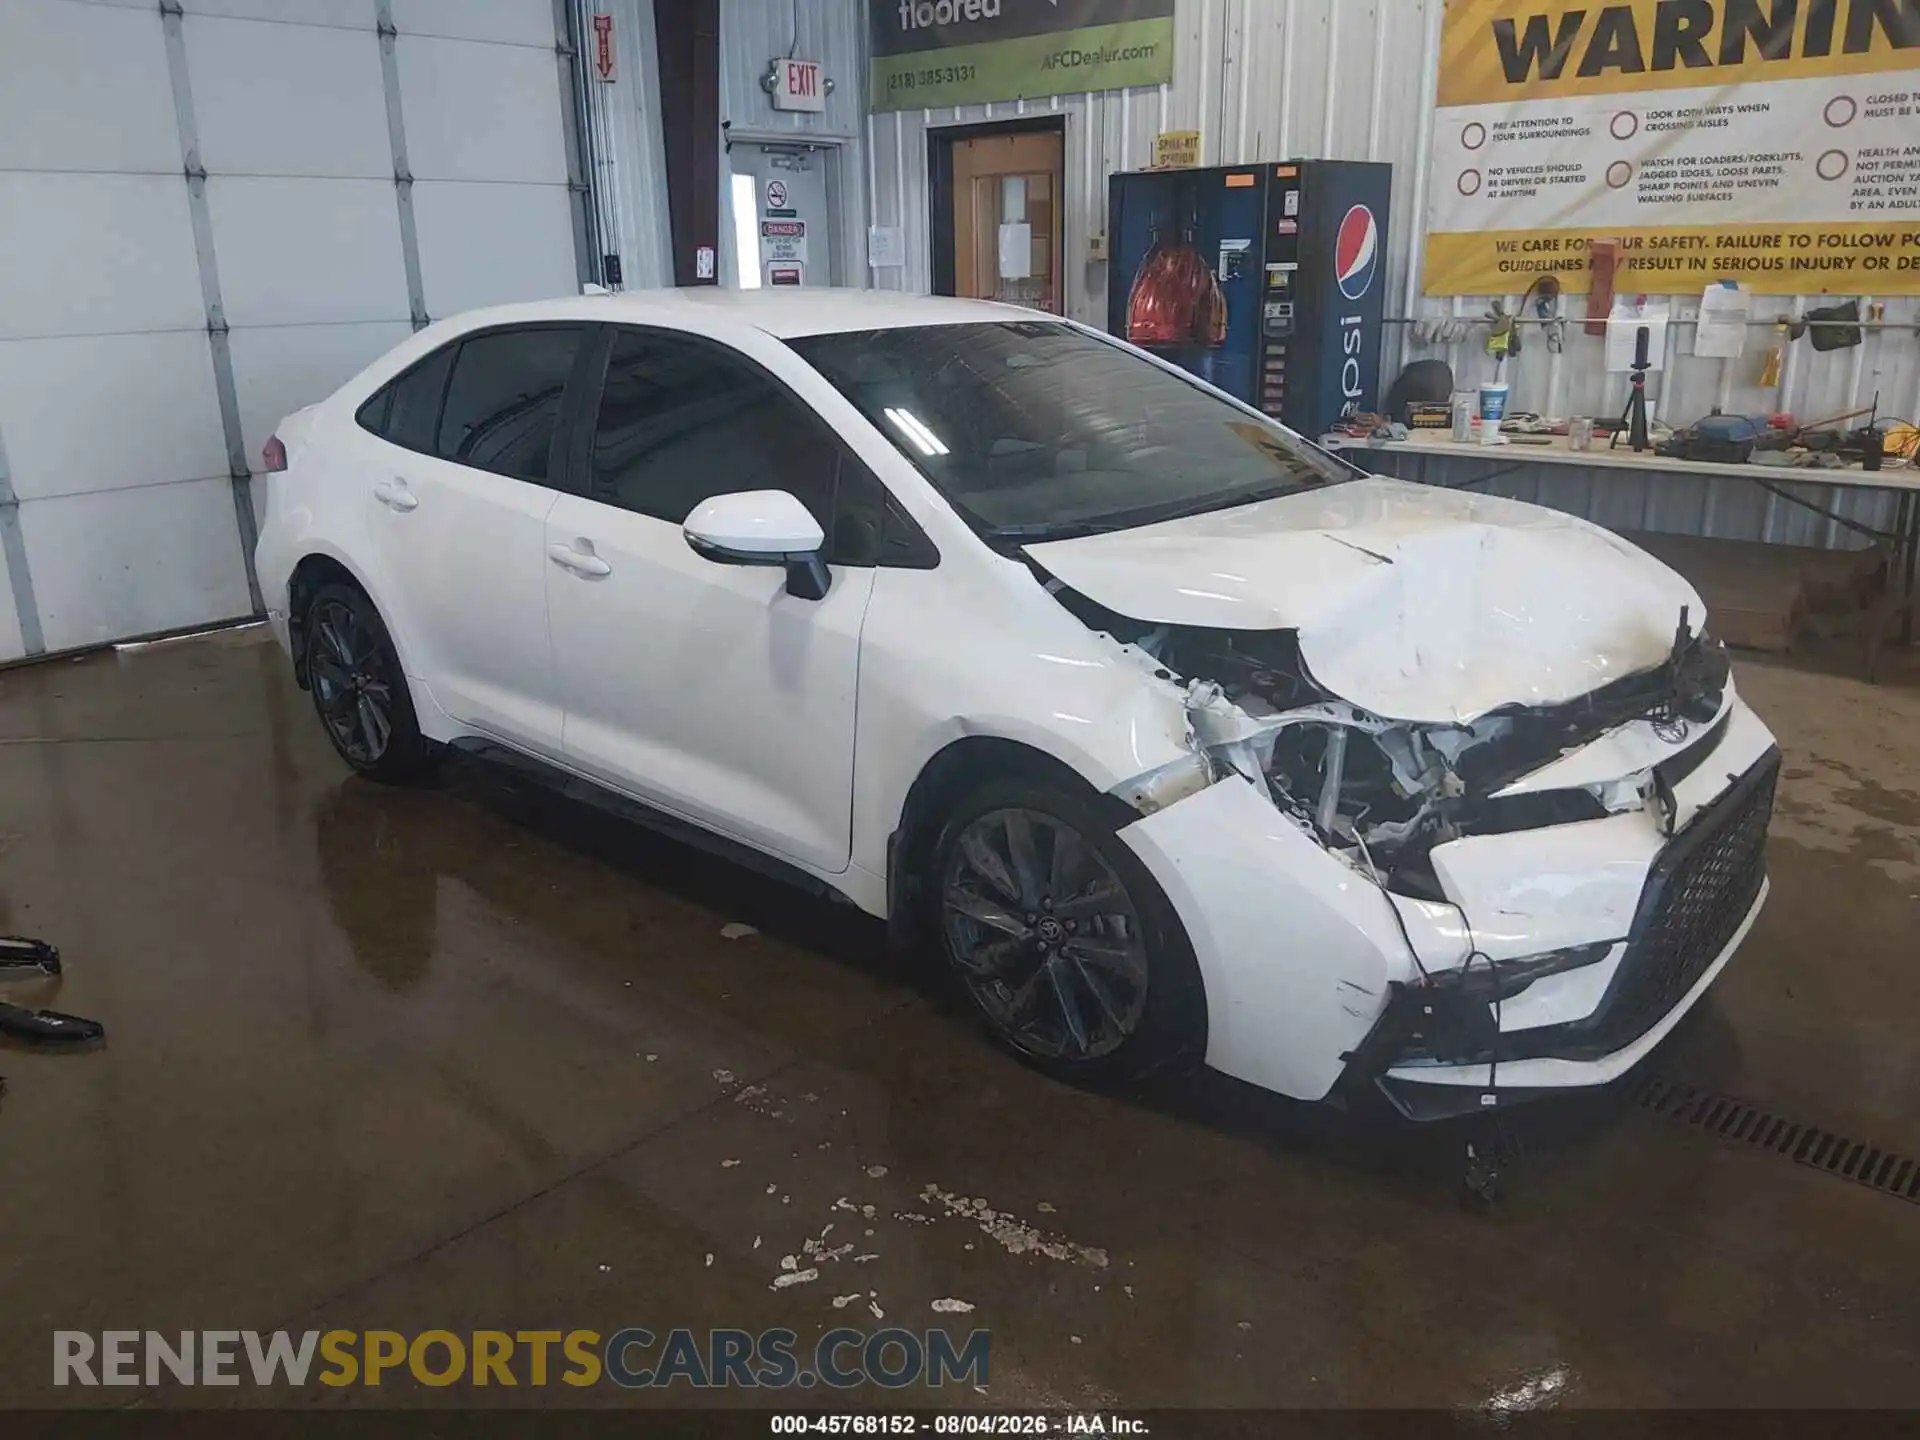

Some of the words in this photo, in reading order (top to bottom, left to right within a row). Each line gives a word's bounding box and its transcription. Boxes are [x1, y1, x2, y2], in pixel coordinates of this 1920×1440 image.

[899, 0, 1000, 30] floored
[789, 63, 817, 96] EXIT
[886, 71, 916, 89] (218)
[1866, 93, 1909, 105] CLOSED
[1646, 111, 1673, 120] LOOK
[1676, 108, 1703, 118] BOTH
[1705, 105, 1734, 116] WAYS
[1737, 103, 1770, 113] WHEN
[1864, 108, 1896, 118] MUST
[1898, 107, 1911, 116] BE
[1493, 122, 1508, 130] PAY
[1510, 118, 1559, 129] ATTENTION
[1561, 117, 1574, 125] TO
[1645, 120, 1694, 131] CROSSING
[1696, 119, 1729, 128] AISLES
[1492, 133, 1515, 141] YOUR
[1518, 128, 1591, 140] SURROUNDINGS
[1858, 147, 1900, 158] HEALTH
[1640, 158, 1674, 167] WATCH
[1677, 157, 1697, 166] FOR
[1856, 161, 1880, 171] NOT
[1488, 167, 1503, 176] NO
[1506, 165, 1544, 175] VEHICLES
[1546, 163, 1583, 173] SHOULD
[1639, 169, 1678, 180] JAGGED
[1717, 167, 1749, 177] LOOSE
[1487, 178, 1498, 187] BE
[1500, 177, 1532, 187] DRIVEN
[1534, 176, 1547, 185] OR
[1549, 174, 1586, 184] STARTED
[1638, 182, 1671, 191] SHARP
[1673, 181, 1709, 191] POINTS
[1711, 180, 1734, 189] AND
[1737, 178, 1779, 188] UNEVEN
[1853, 173, 1905, 184] AUCTION
[1487, 190, 1497, 199] AT
[1500, 189, 1537, 198] ANYTIME
[1888, 186, 1917, 196] EVEN
[1637, 193, 1684, 204] WALKING
[1850, 201, 1865, 210] BY
[1867, 200, 1885, 209] AN
[768, 224, 798, 234] DANGER
[1495, 240, 1518, 253] WE
[1522, 238, 1560, 252] CARE
[1611, 236, 1644, 250] UR
[1648, 234, 1709, 250] SAFETY.
[1716, 234, 1782, 249] FAILURE
[1788, 233, 1811, 248] TO
[1817, 233, 1896, 248] FOLLOW
[1498, 258, 1583, 273] GUIDELINES
[1628, 256, 1684, 271] RESULT
[1688, 256, 1707, 271] IN
[1712, 256, 1784, 271] SERIOUS
[1790, 255, 1856, 270] INJURY
[1862, 256, 1890, 270] OR
[1897, 255, 1920, 270] DE
